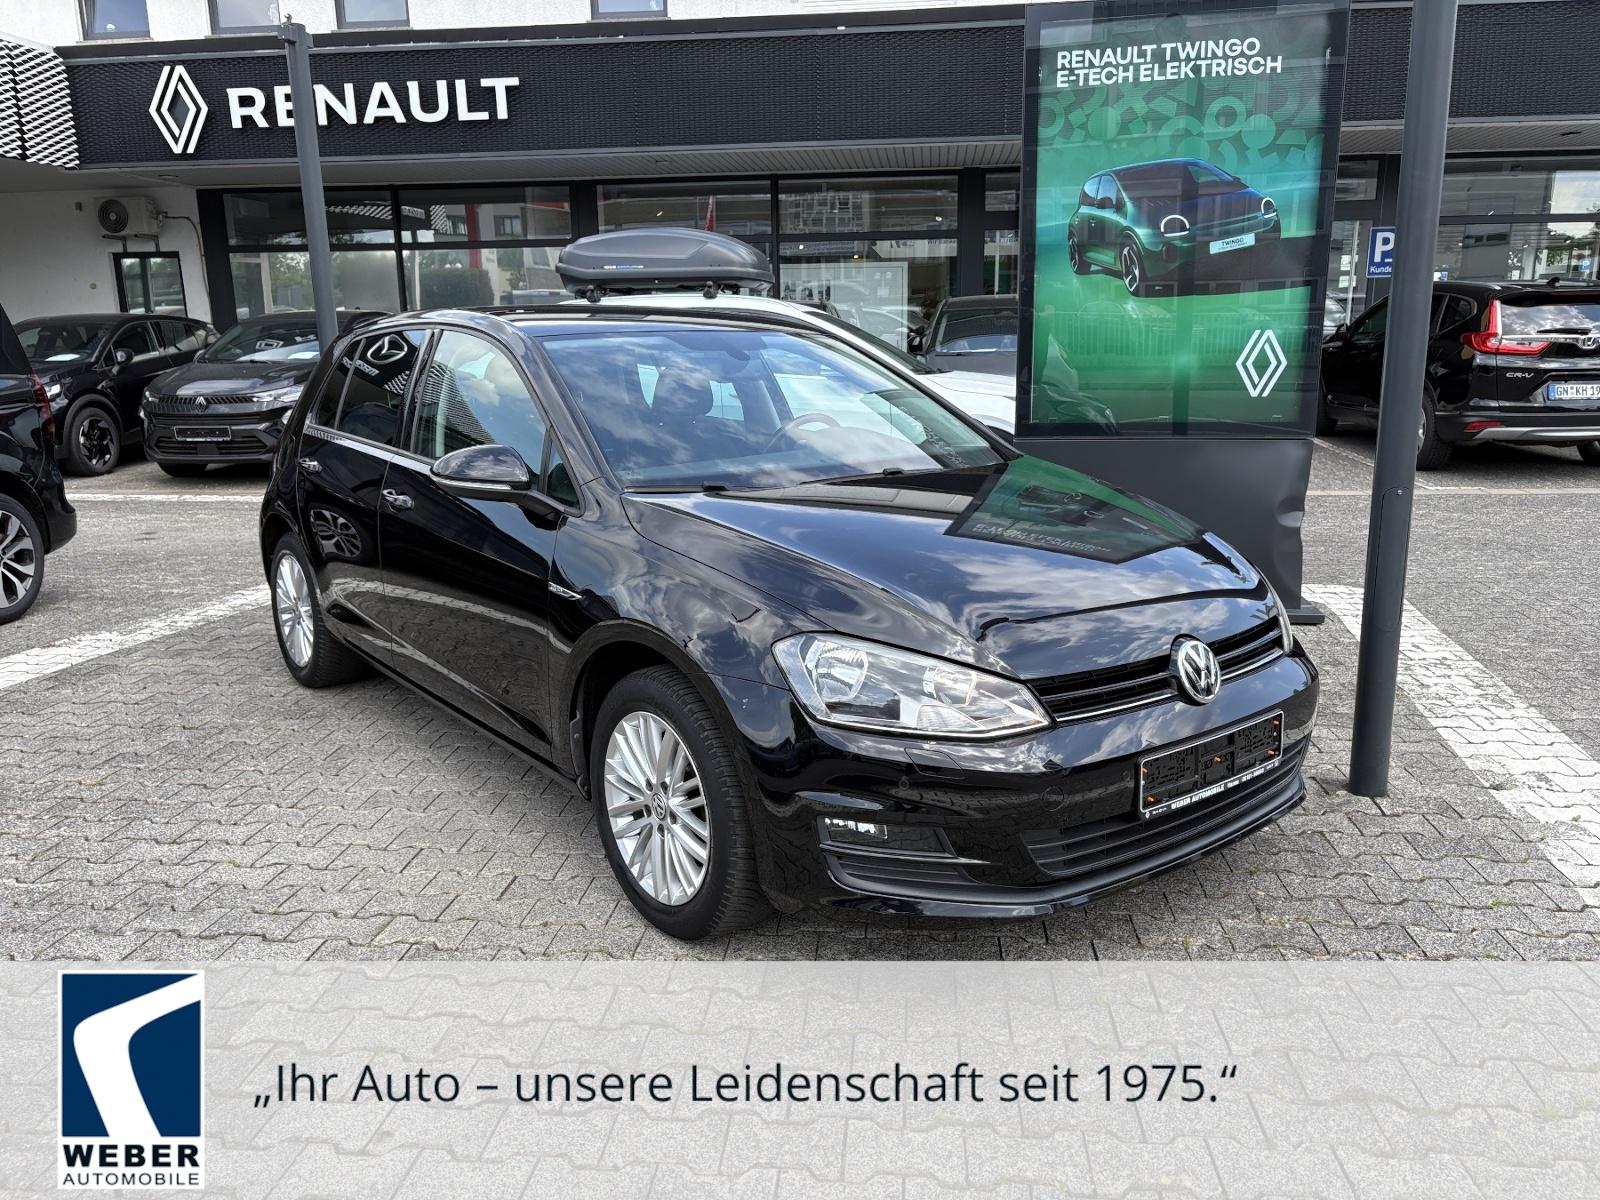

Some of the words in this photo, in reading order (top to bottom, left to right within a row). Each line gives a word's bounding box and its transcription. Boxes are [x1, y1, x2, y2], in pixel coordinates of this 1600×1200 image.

[1057, 44, 1157, 68] RENAULT
[1164, 37, 1261, 61] TWINGO
[1056, 65, 1134, 88] E-TECH
[1139, 55, 1283, 82] ELEKTRISCH
[226, 77, 521, 129] RENAULT
[1373, 231, 1396, 263] P
[1556, 386, 1569, 396] GN
[1575, 386, 1588, 396] KH
